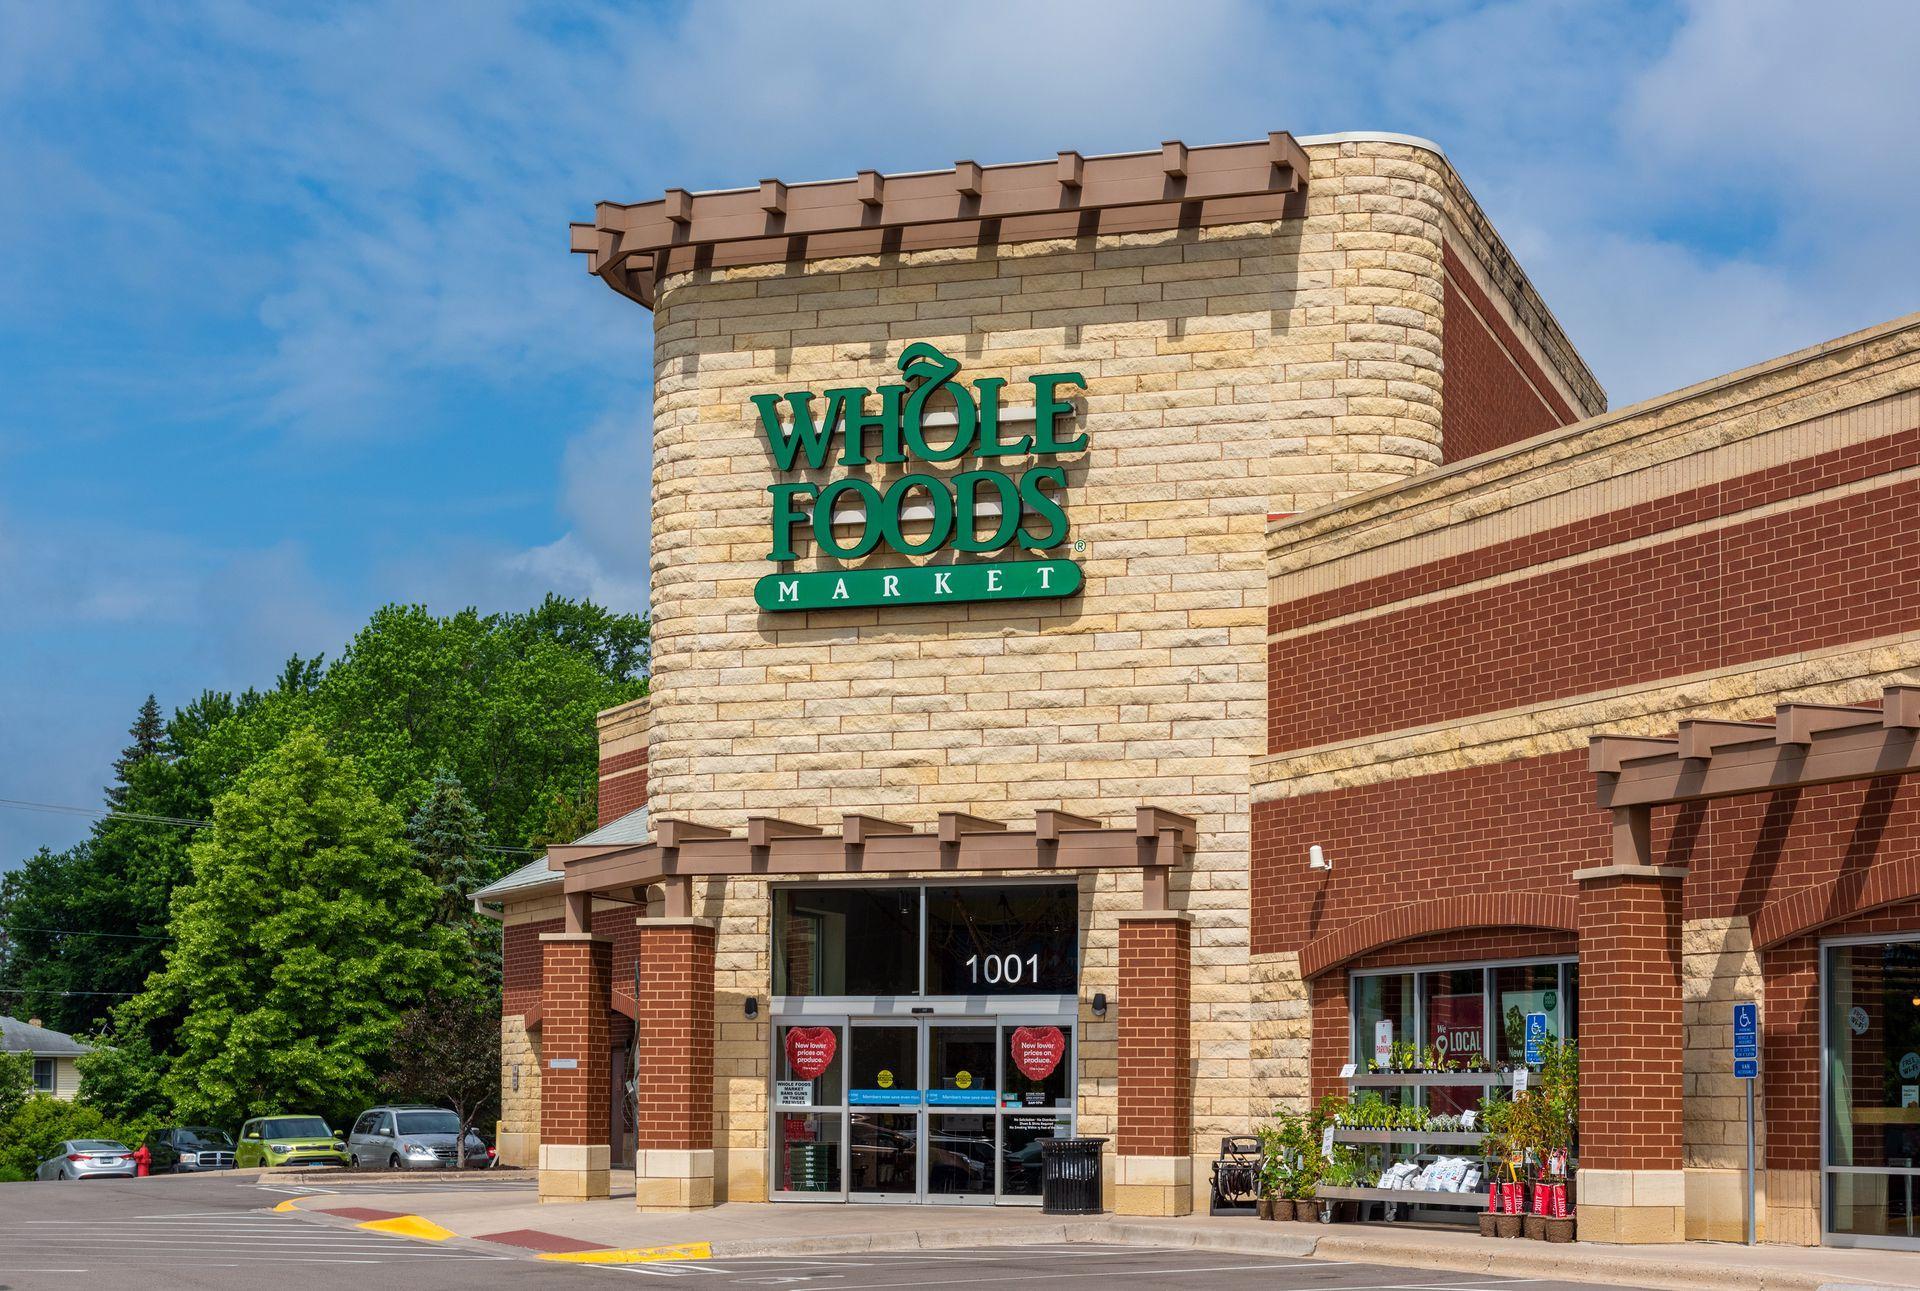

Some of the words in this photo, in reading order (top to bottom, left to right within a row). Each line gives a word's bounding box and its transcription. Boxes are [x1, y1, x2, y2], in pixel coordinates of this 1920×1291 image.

[750, 371, 1088, 472] WHOLE
[766, 466, 1070, 562] FOODS
[778, 566, 1055, 602] MARKET
[966, 953, 1038, 984] 1001
[1437, 1024, 1447, 1033] We
[1381, 1035, 1388, 1044] NO
[1450, 1031, 1481, 1051] LOCAL
[797, 1049, 815, 1057] prices
[1508, 1047, 1524, 1057] New
[1535, 1196, 1543, 1214] FRUIT
